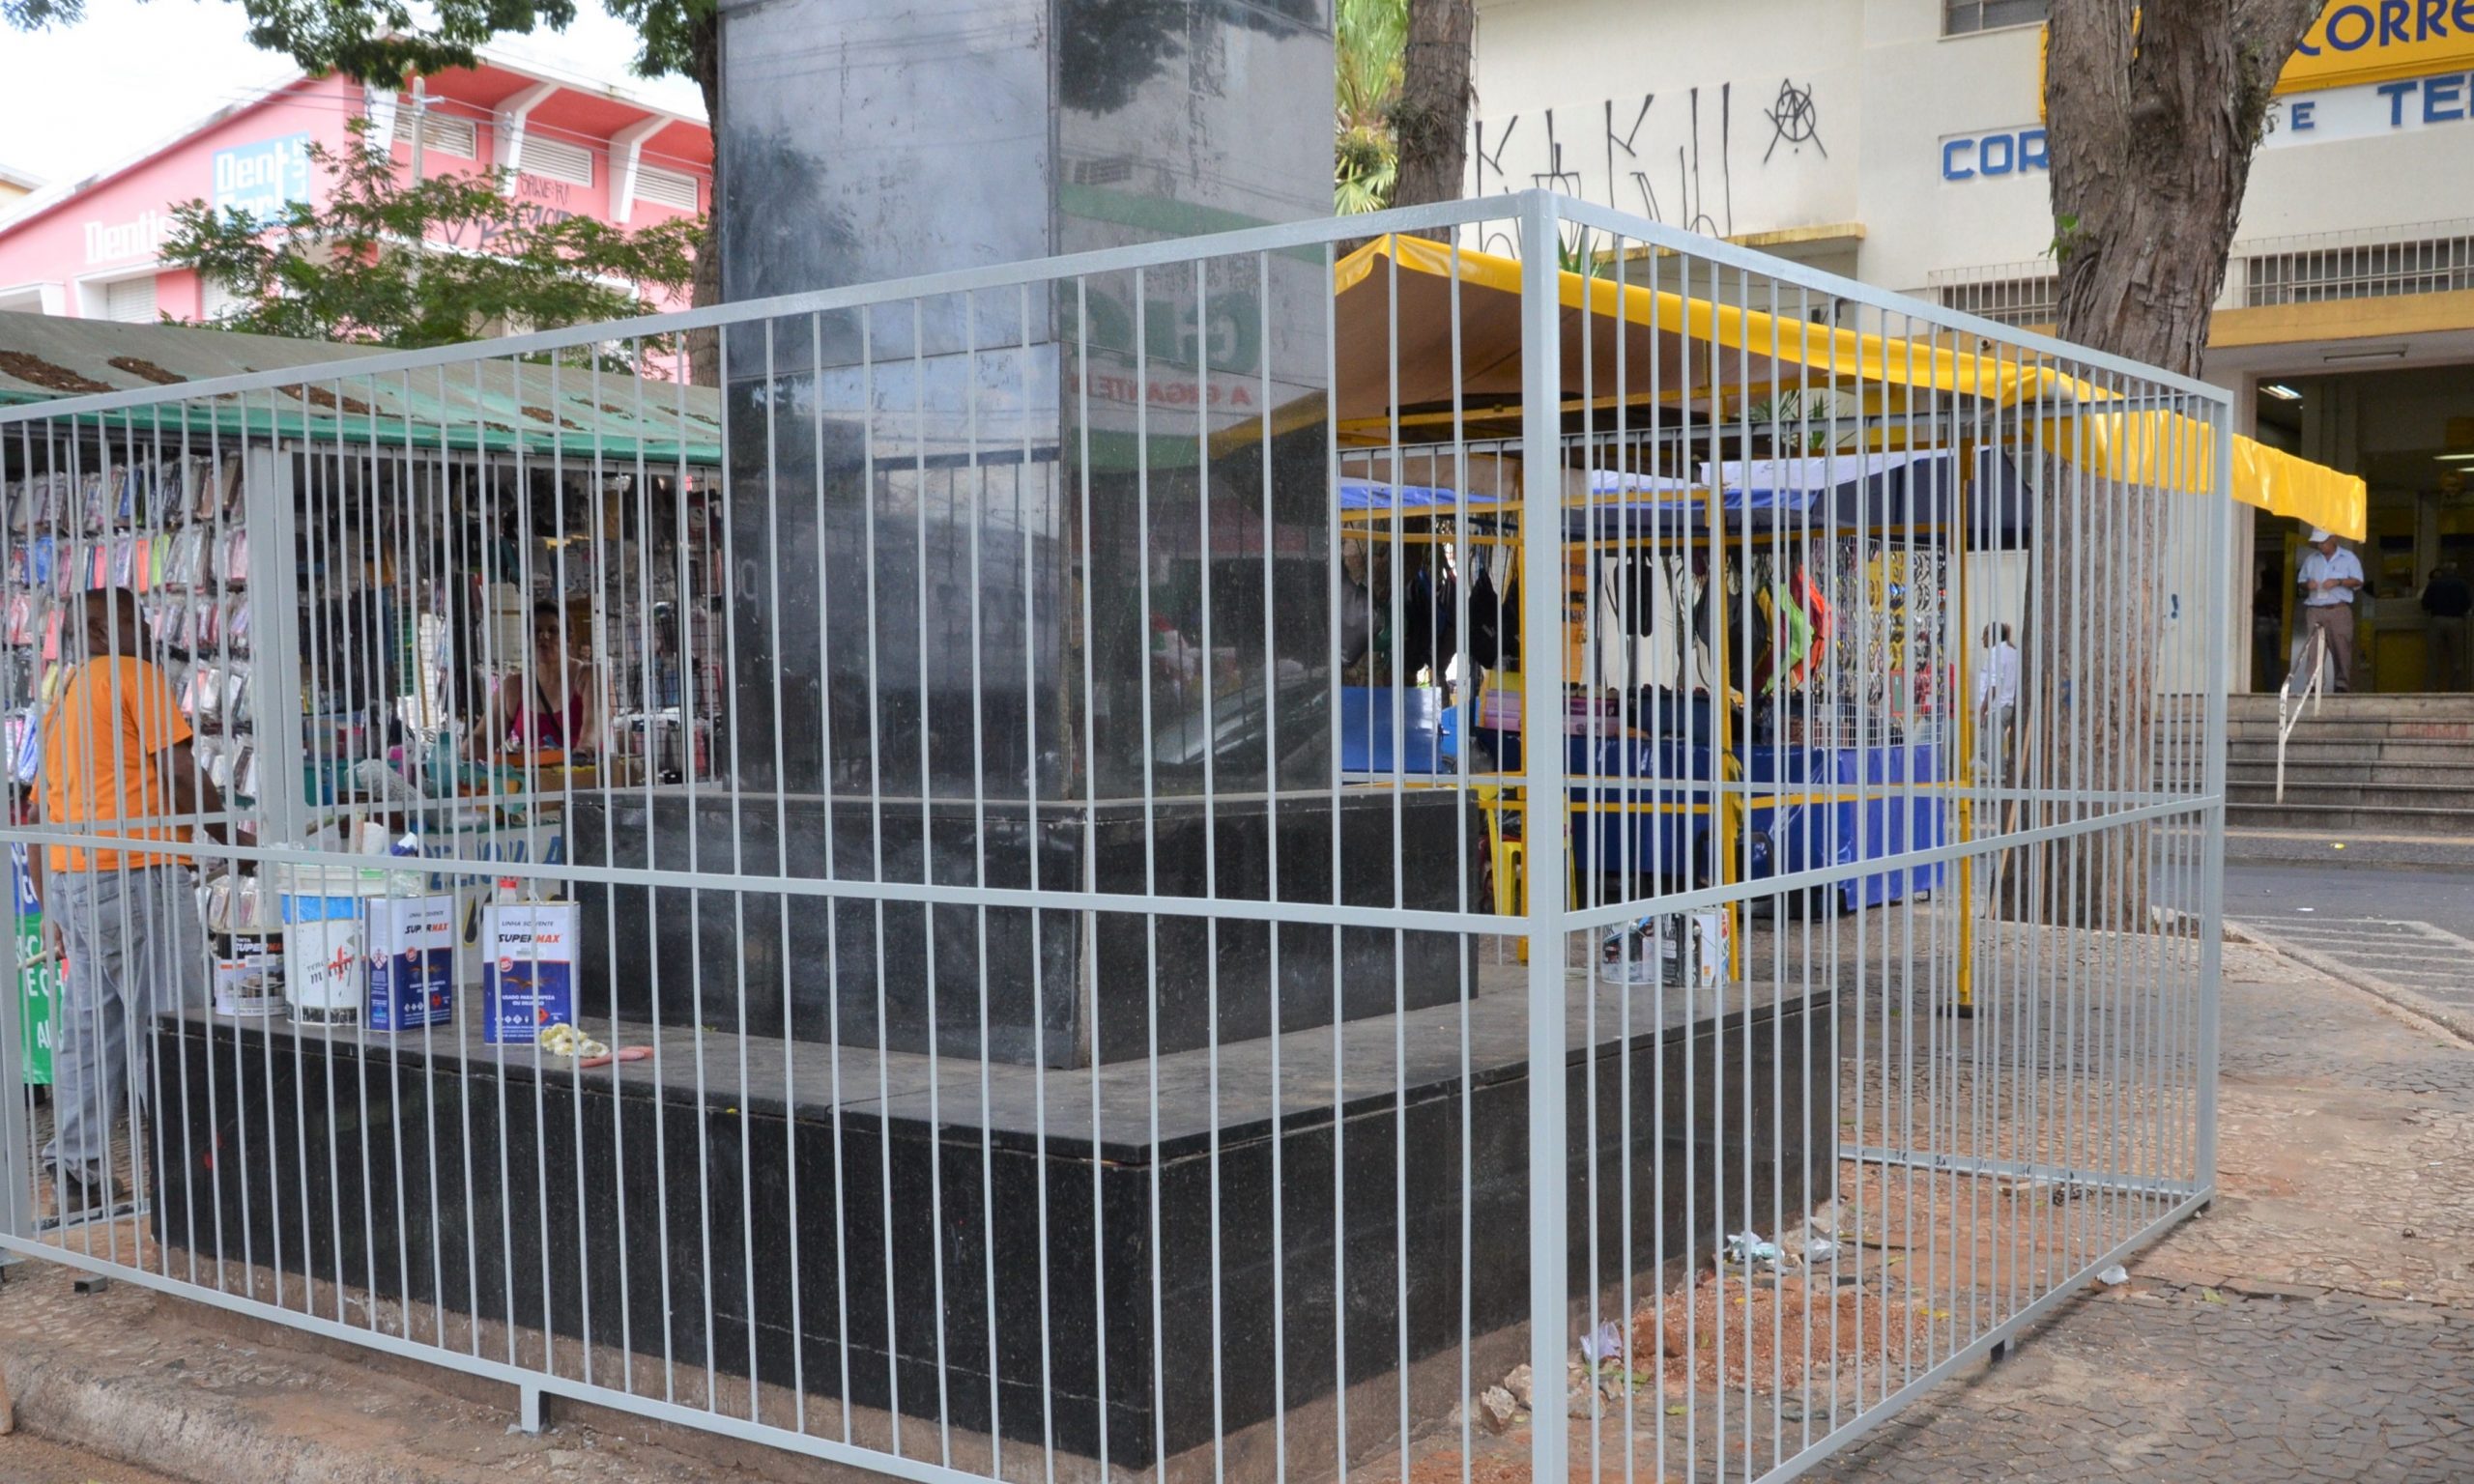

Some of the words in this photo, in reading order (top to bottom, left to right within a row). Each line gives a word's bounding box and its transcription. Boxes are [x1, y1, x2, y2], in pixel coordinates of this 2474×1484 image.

[2296, 0, 2474, 55] ORR
[2291, 101, 2316, 130] E
[2377, 75, 2474, 127] TE
[404, 922, 449, 934] SUPRMAX
